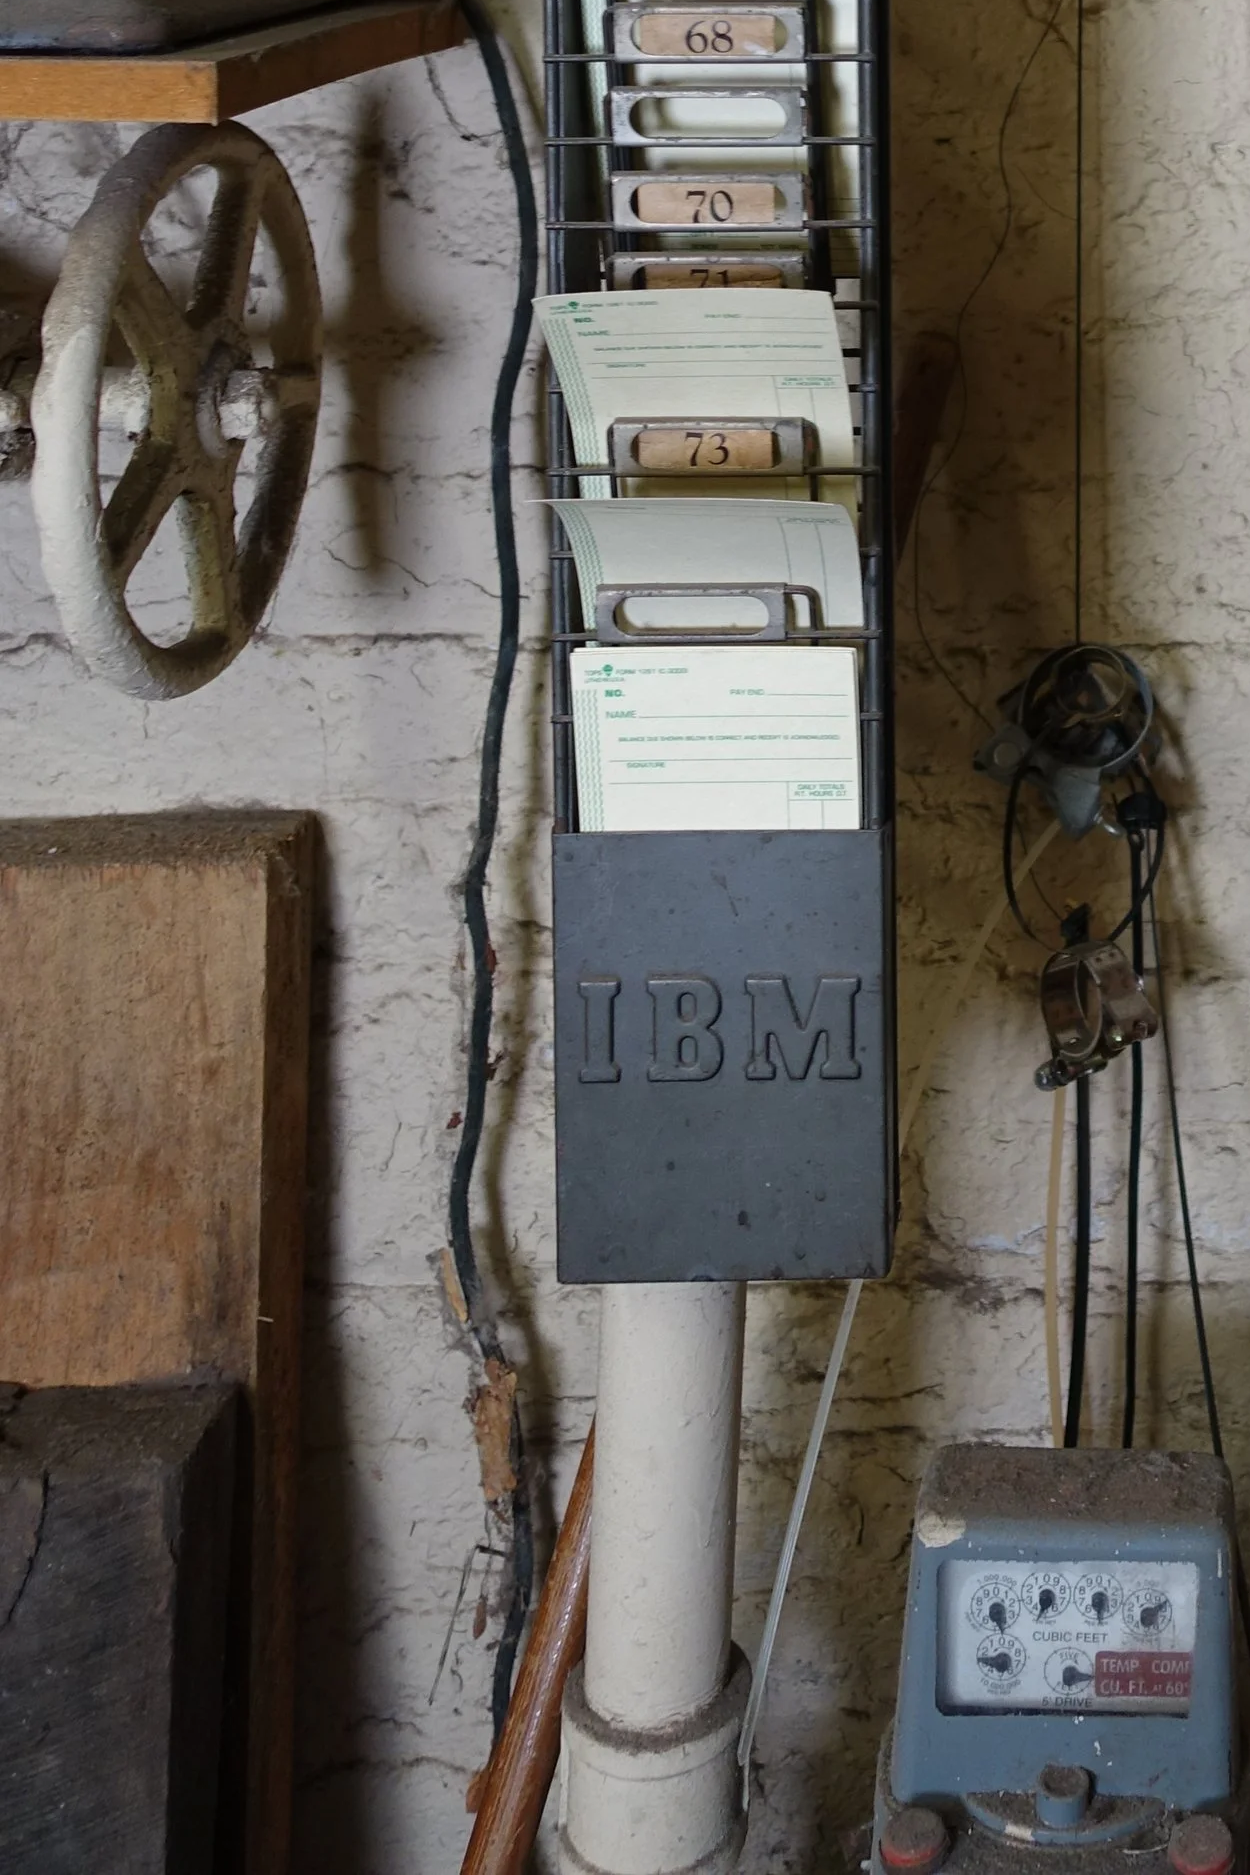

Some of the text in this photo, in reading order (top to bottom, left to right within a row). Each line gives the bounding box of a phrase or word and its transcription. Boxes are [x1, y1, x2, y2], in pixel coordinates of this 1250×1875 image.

[685, 20, 734, 54] 68
[685, 190, 734, 224] 70
[684, 432, 730, 467] 73
[605, 689, 626, 698] NO.
[606, 710, 637, 719] NAME
[626, 761, 666, 769] SIGNATURE
[797, 783, 846, 791] DAILY TOTALS
[578, 976, 862, 1084] IBM
[1032, 1631, 1109, 1644] CUBIC FEET
[1101, 1659, 1140, 1673] TEMP
[1100, 1679, 1124, 1694] CU.
[1128, 1680, 1148, 1694] FT.
[1055, 1696, 1094, 1708] DRIVE
